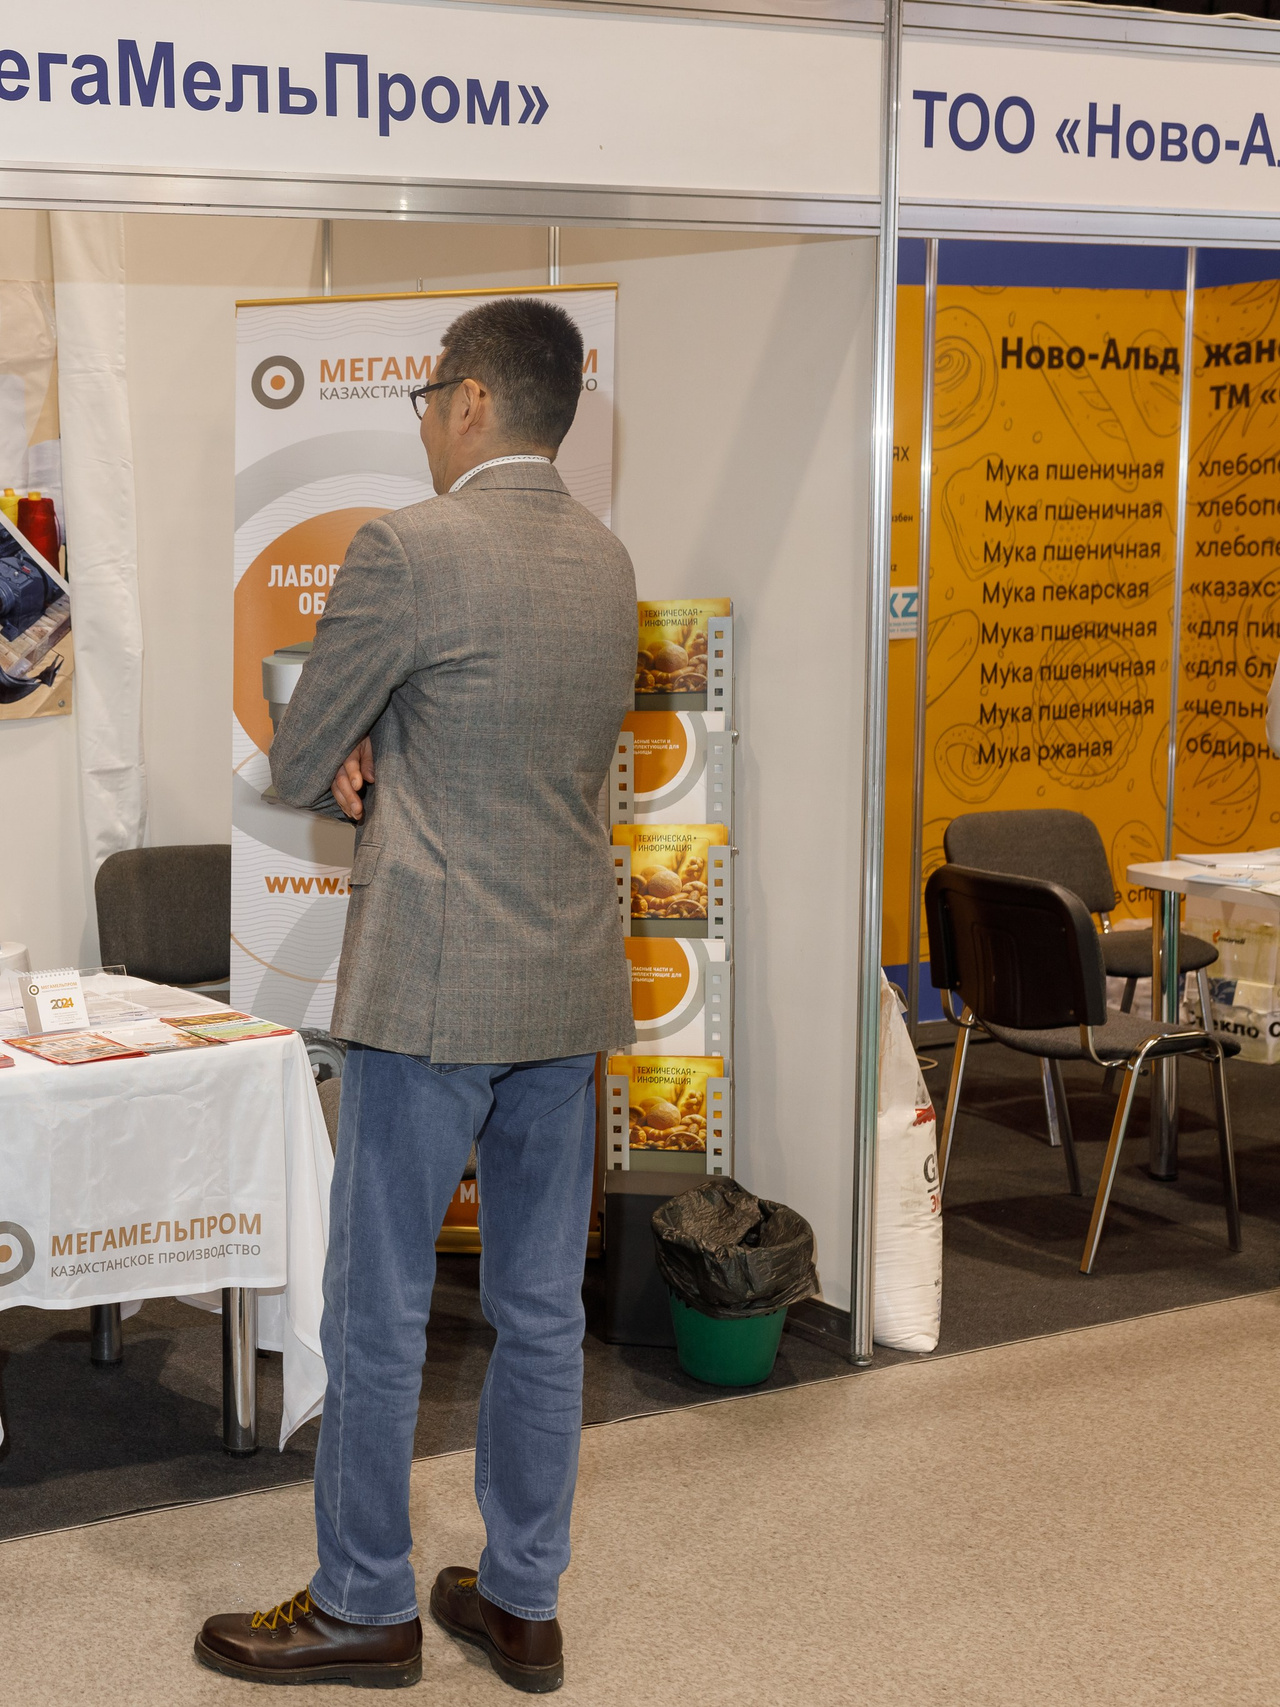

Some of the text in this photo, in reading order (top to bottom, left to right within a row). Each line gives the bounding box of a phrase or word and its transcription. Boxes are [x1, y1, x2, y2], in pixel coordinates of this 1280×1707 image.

[912, 89, 1280, 167] ТОО «Ново-А
[1203, 338, 1280, 369] жан
[1209, 383, 1251, 411] ТМ
[986, 453, 1280, 486] Мука пшеничная хлебоп
[985, 500, 1038, 527] Мука
[1045, 501, 1163, 521] пшеничная
[984, 540, 1036, 567] Мука
[1044, 541, 1161, 561] пшеничная
[268, 564, 341, 587] ЛАБОР
[983, 581, 1035, 608] Мука
[1042, 581, 1149, 605] пекарская
[644, 608, 698, 618] ТЕХНИЧЕСКАЯ
[644, 618, 698, 627] ИНФОРМАЦИЯ
[982, 622, 1034, 649] Мука
[1041, 620, 1157, 642] пшеничная
[1187, 620, 1238, 639] «для
[980, 662, 1033, 690] Мука
[1040, 659, 1156, 682] пшеничная
[1185, 660, 1237, 679] «для
[979, 698, 1268, 730] Мука пшеничная «цельн
[978, 743, 1030, 771] Мука
[1037, 738, 1113, 766] ржаная
[638, 834, 692, 843] ТЕХНИЧЕСКАЯ
[638, 843, 692, 852] ИНФОРМАЦИЯ
[265, 876, 352, 896] www.
[50, 997, 74, 1010] 2024
[637, 1066, 692, 1076] ТЕХНИЧЕСКАЯ
[637, 1075, 692, 1085] ИНФОРМАЦИЯ
[51, 1213, 262, 1257] МЕГАМЕЛЬПРОМ
[51, 1243, 261, 1277] КАЗАХСТАНСКОЕ ПРОИЗВОДСТВО
